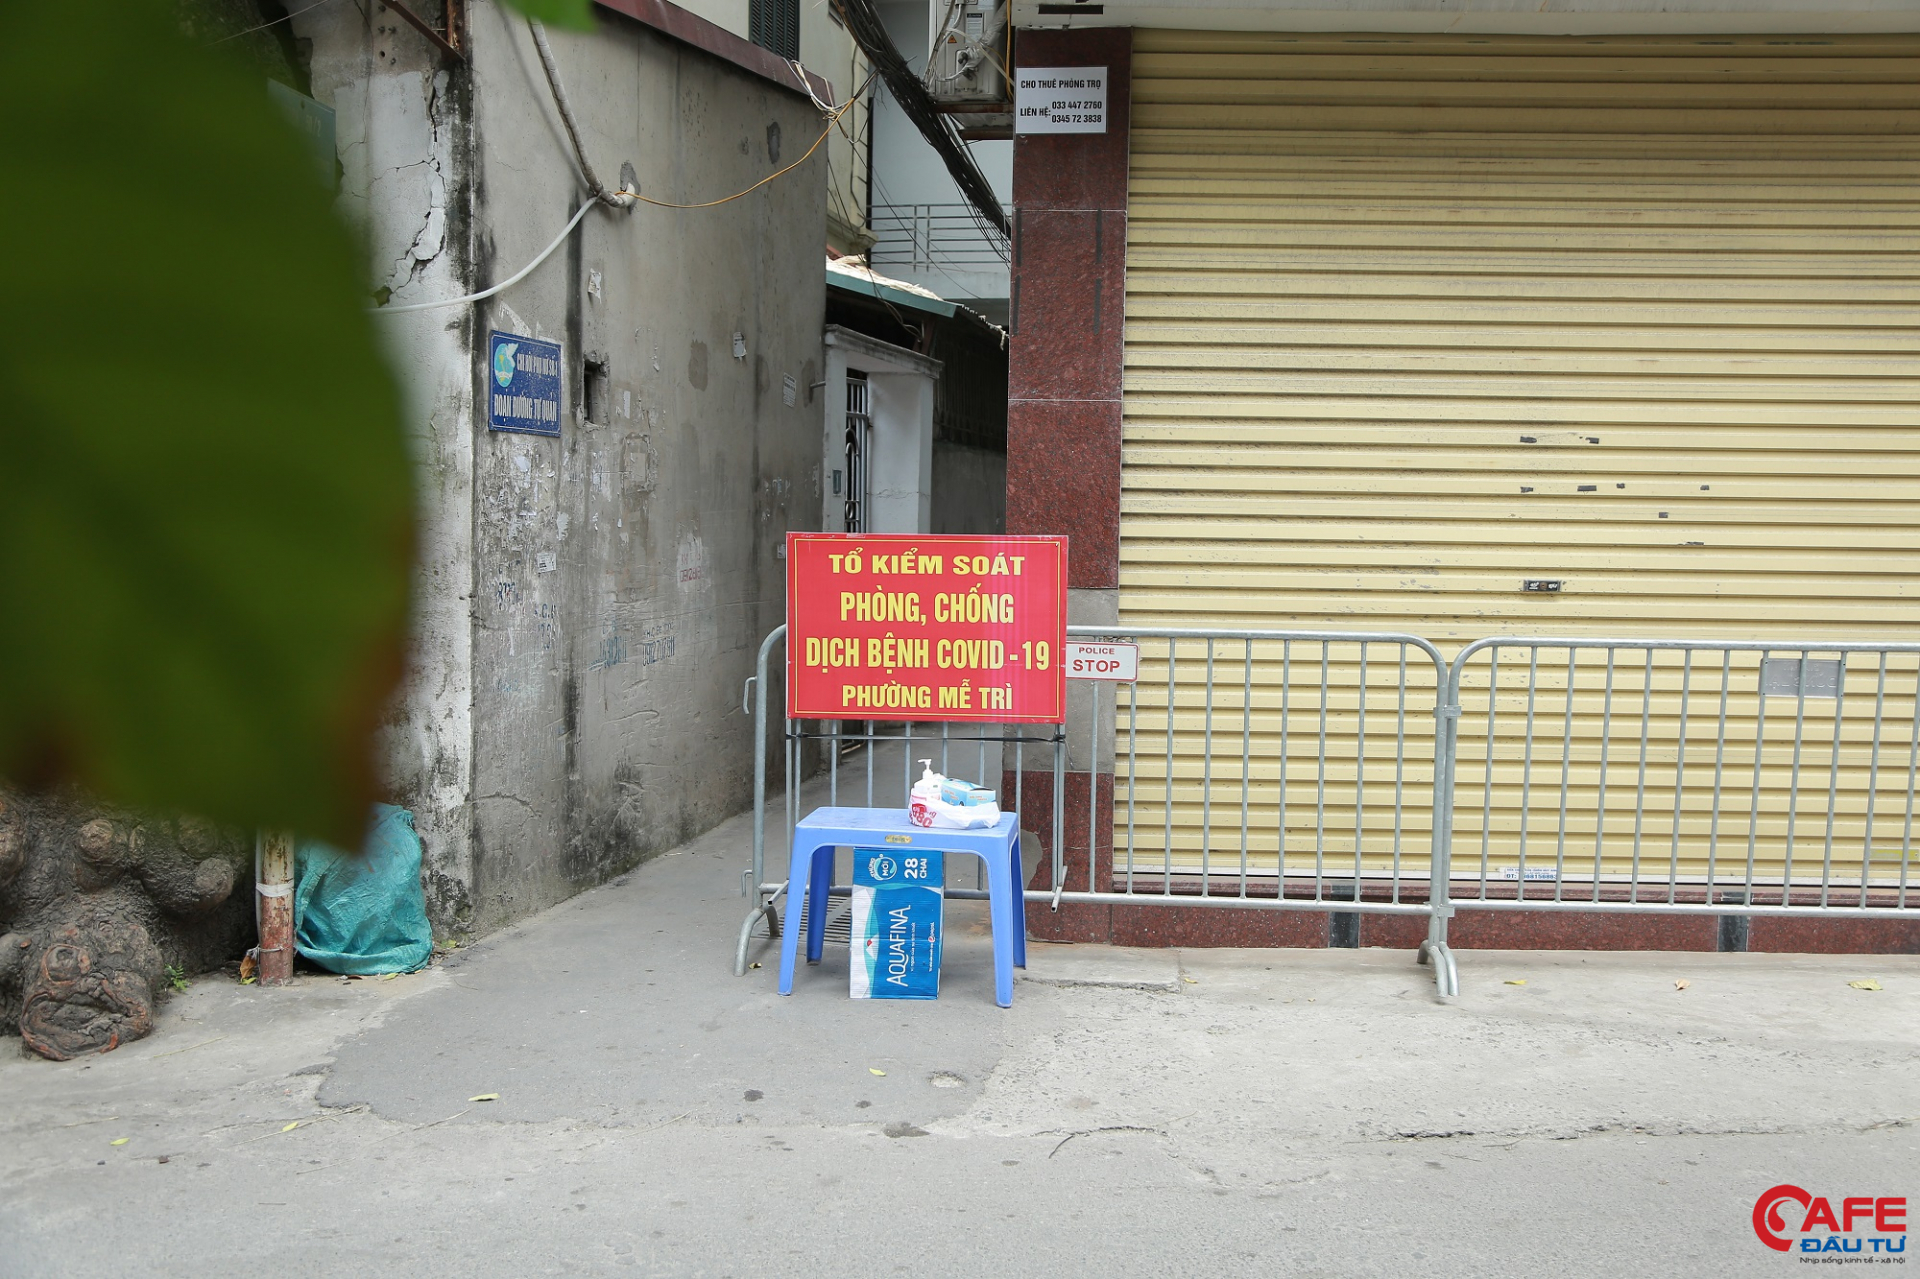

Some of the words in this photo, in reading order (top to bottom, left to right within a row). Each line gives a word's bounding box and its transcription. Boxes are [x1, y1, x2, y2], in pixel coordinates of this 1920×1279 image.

[1020, 80, 1036, 88] CHO
[1038, 78, 1057, 88] THUÊ
[1059, 78, 1085, 88] PHÒNG
[1086, 80, 1101, 90] TRỌ
[1020, 106, 1037, 116] LIÊN
[1039, 106, 1051, 118] HỆ:
[1052, 101, 1066, 110] 033
[1068, 101, 1082, 110] 447
[1084, 101, 1102, 109] 2760
[1052, 115, 1070, 123] 0345
[1072, 115, 1082, 123] 72
[1083, 115, 1102, 123] 3838
[494, 393, 511, 422] ĐOẠN
[828, 546, 863, 574] TỔ
[872, 547, 943, 575] KIỂM
[952, 552, 1025, 576] SOÁT
[840, 584, 927, 626] PHÒNG,
[934, 583, 1014, 624] CHỐNG
[806, 637, 860, 674] DỊCH
[867, 632, 930, 674] BỆNH
[1078, 646, 1115, 655] POLICE
[1072, 658, 1120, 674] STOP
[842, 681, 931, 708] PHƯỜNG
[939, 678, 972, 709] MỄ
[978, 683, 1013, 710] TRÌ
[881, 860, 889, 876] MỚI
[904, 858, 919, 879] 28
[886, 904, 912, 987] AQUAFINA
